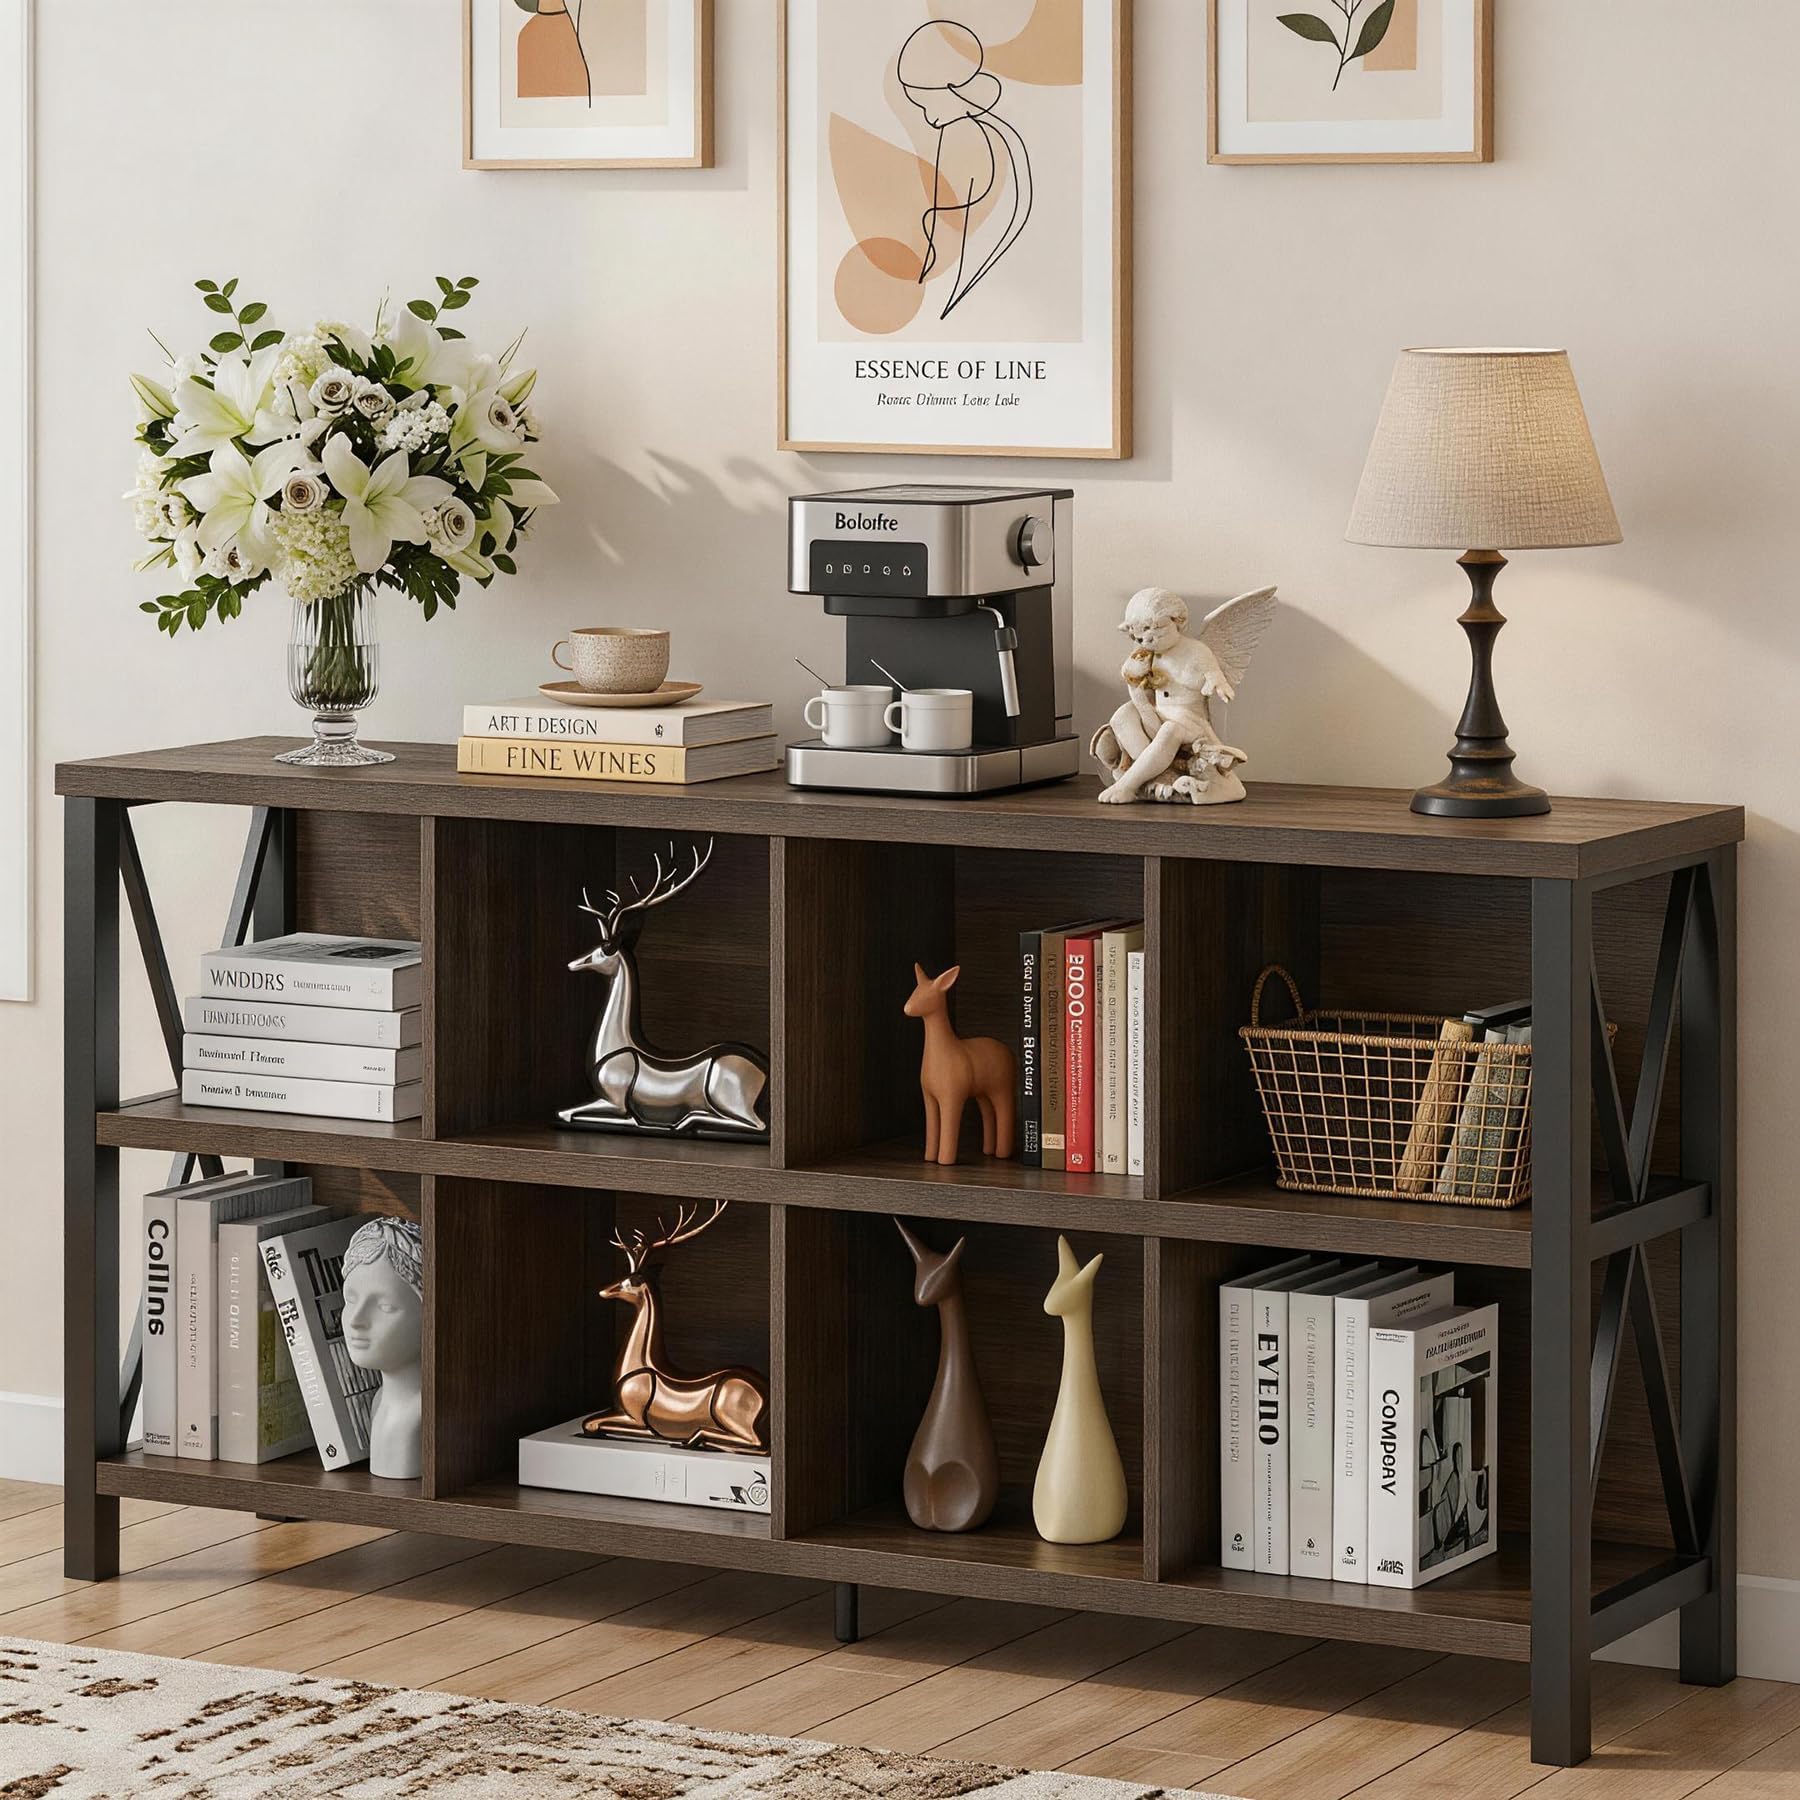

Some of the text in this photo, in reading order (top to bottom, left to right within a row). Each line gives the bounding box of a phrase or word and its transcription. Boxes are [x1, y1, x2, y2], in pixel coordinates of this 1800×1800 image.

[854, 359, 1048, 381] ESSENCE OF LINE
[488, 714, 520, 733] ART
[537, 716, 599, 736] DESIGN
[506, 746, 657, 776] FINE WINES
